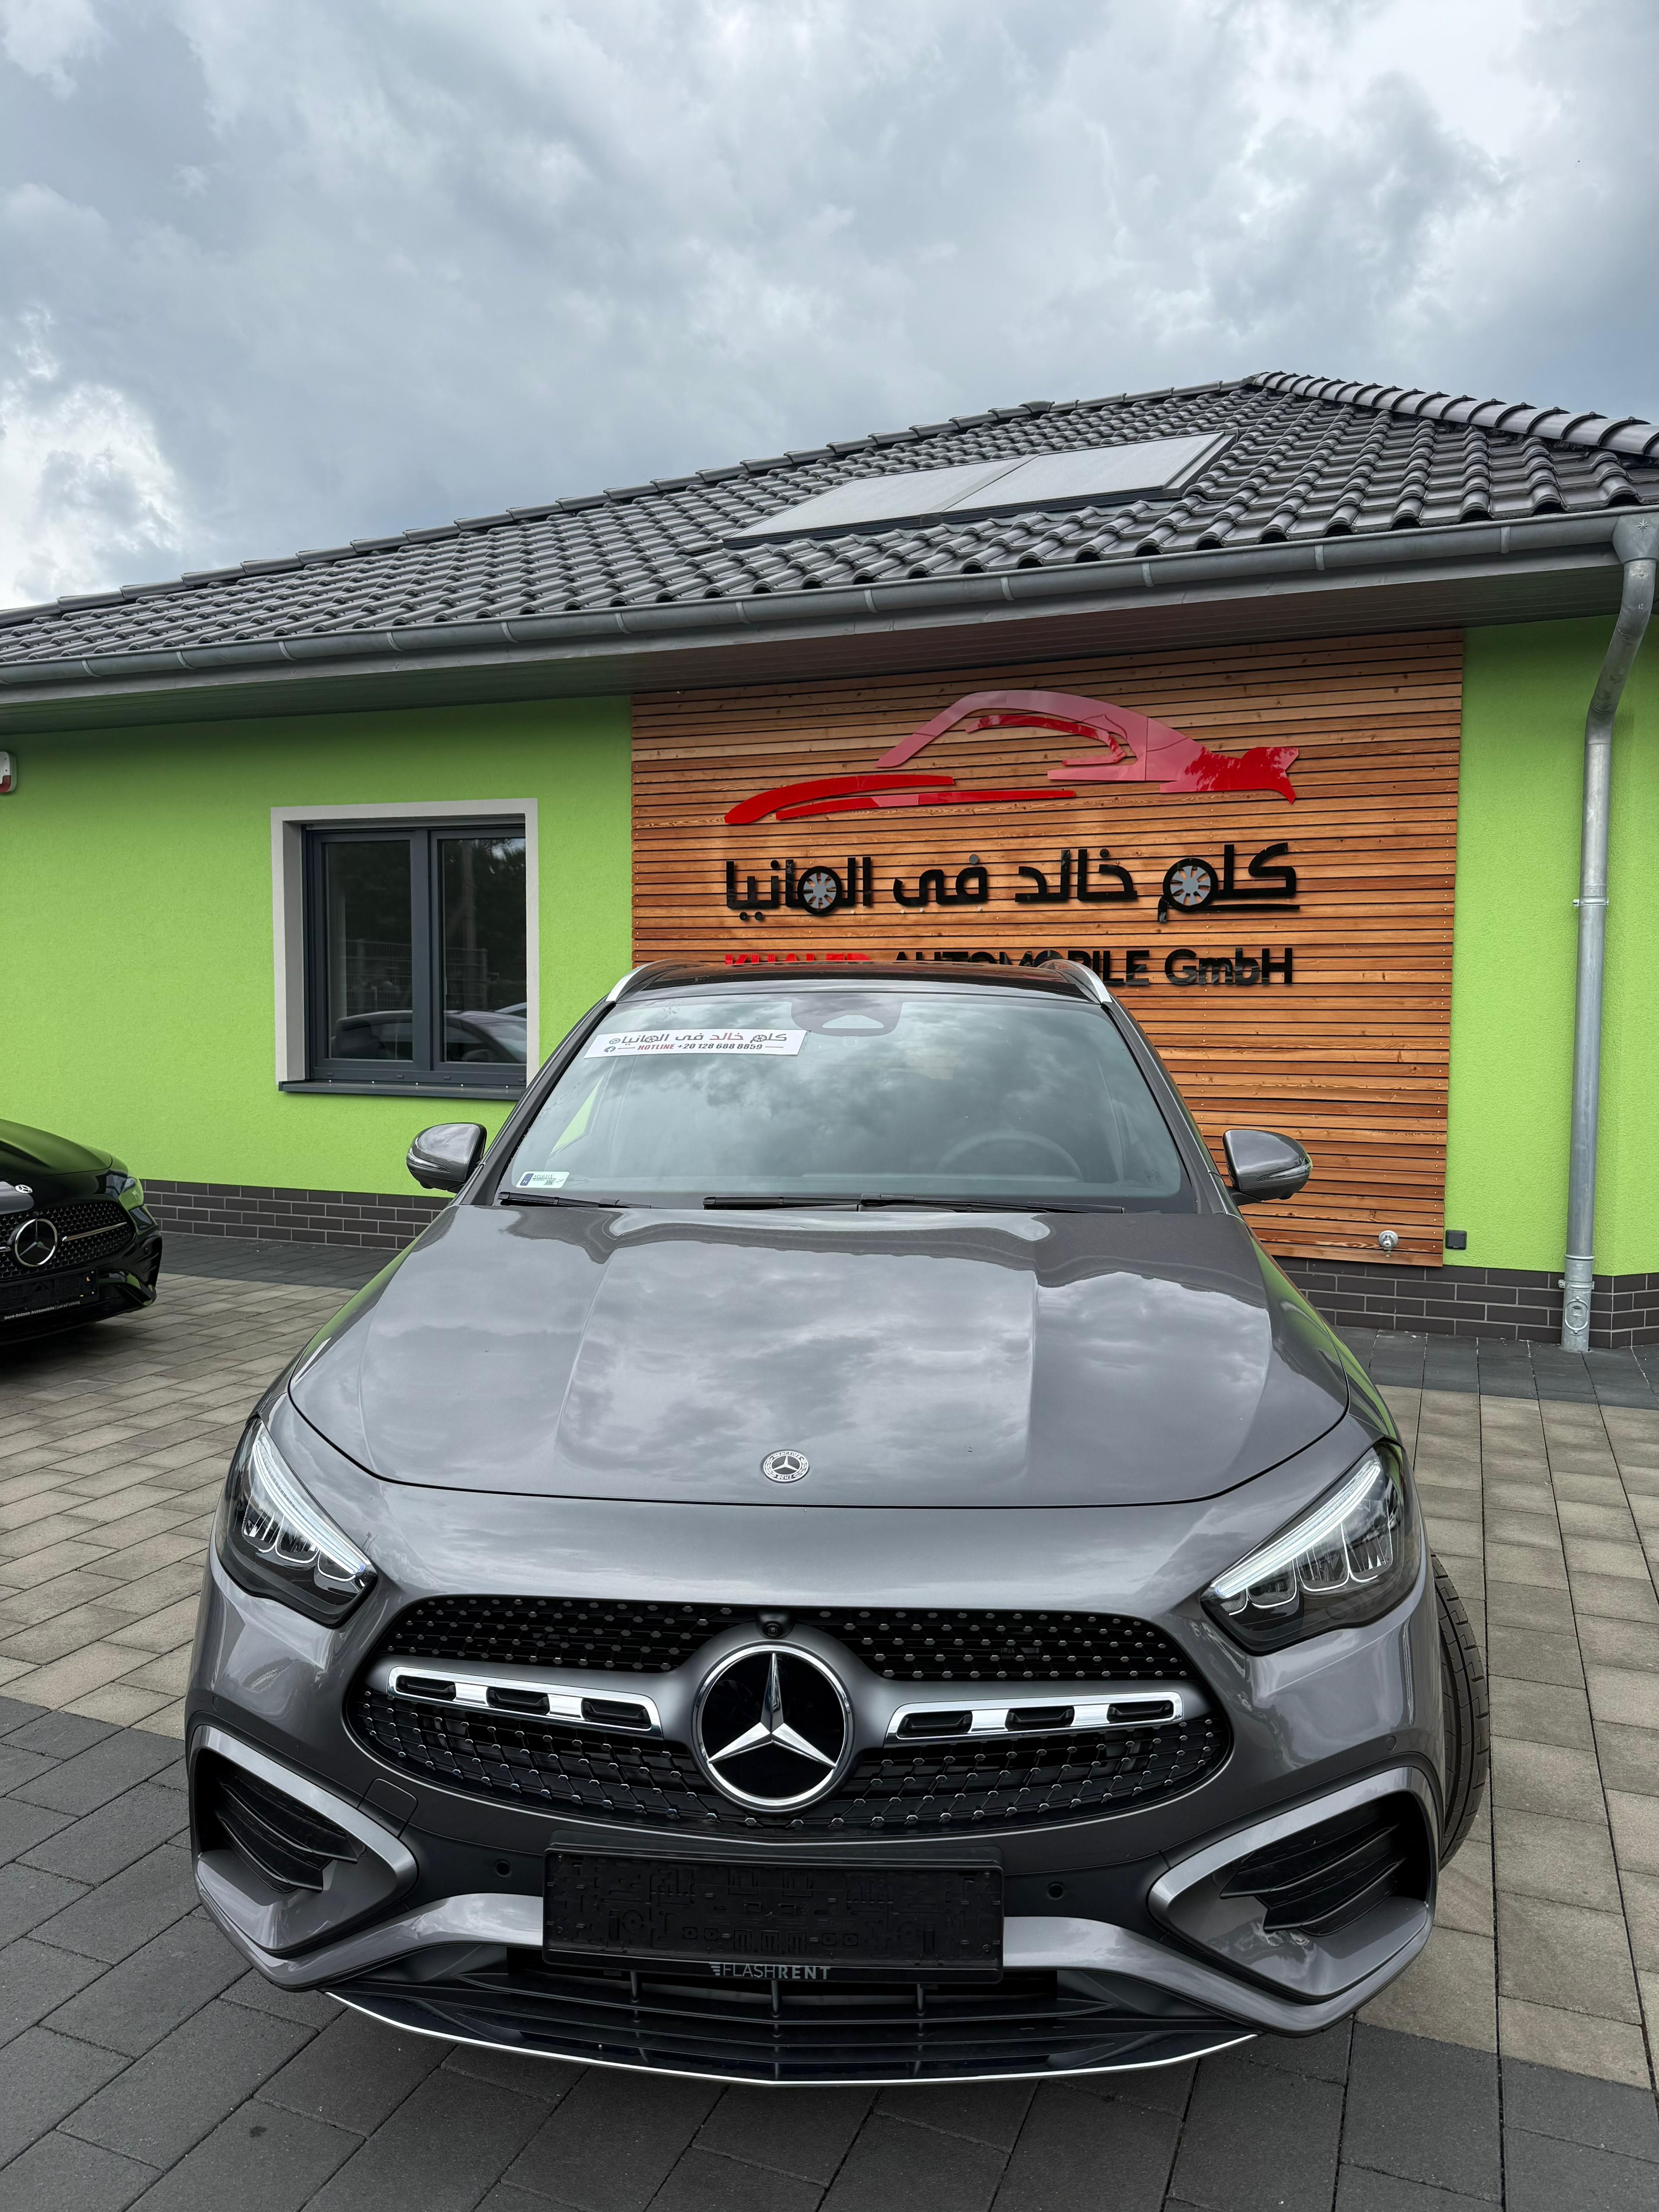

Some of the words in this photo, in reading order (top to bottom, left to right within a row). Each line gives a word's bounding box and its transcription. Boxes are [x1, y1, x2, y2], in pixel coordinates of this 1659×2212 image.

[1015, 849, 1137, 902] خالد
[1164, 947, 1293, 985] GmbH
[723, 1964, 831, 1980] FLASHRENT
